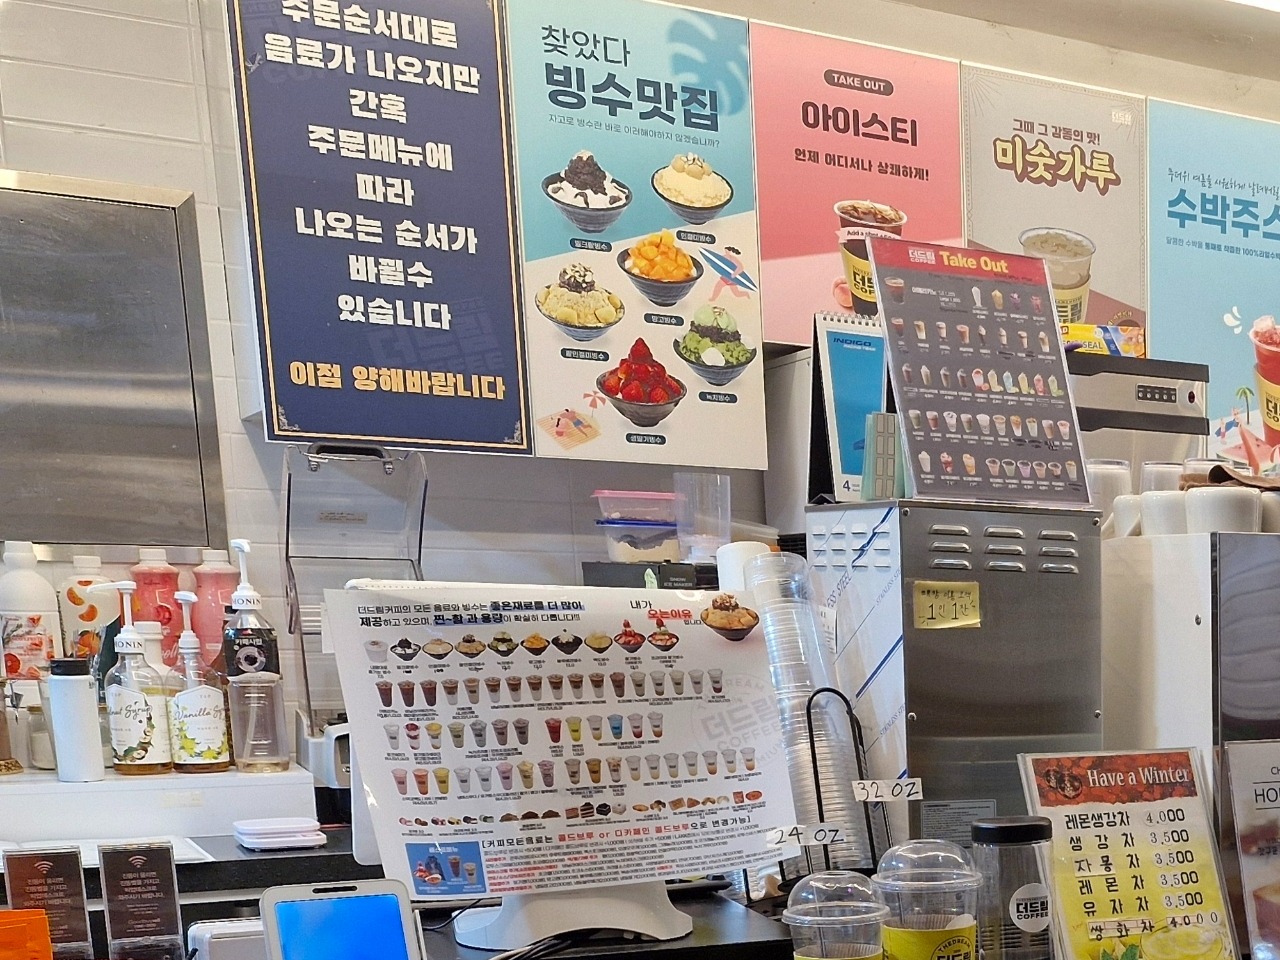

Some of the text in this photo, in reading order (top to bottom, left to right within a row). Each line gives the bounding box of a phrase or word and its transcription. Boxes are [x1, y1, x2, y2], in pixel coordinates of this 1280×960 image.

[282, 0, 458, 49] 주문순서대로
[542, 25, 630, 67] 찾았다
[265, 33, 480, 94] 음료가 나오지만
[832, 73, 886, 92] TAKE OUT
[349, 89, 406, 123] 간혹
[545, 63, 719, 132] 빙수맛집
[549, 114, 720, 148] 자고로 빙수란 바로 이러해야하지 않겠습니까?
[802, 101, 918, 147] 아이스티
[1012, 119, 1100, 145] 그때 그 감동의 맛!
[308, 125, 453, 171] 주문메뉴에
[795, 148, 929, 181] 언제 어디서나 상쾌하게!
[994, 135, 1121, 195] 미숫가루
[356, 173, 414, 206] 따라
[295, 208, 477, 253] 나오는 순서가
[1166, 237, 1183, 246] 달콤한
[1205, 242, 1222, 251] 통째로
[939, 251, 1008, 273] Take Out
[337, 295, 452, 330] 있습니다
[833, 338, 871, 346] INDIGO
[290, 362, 505, 399] 이점 양해바랍니다
[358, 605, 411, 614] 더드림커피의
[414, 604, 432, 613] 모든
[434, 603, 459, 612] 음료와
[548, 602, 558, 610] 더
[561, 601, 582, 610] 많이
[630, 600, 652, 609] 내가
[648, 609, 692, 619] 오는이유
[360, 617, 432, 627] 제공하고 있으며,
[174, 707, 211, 720] Vanilla
[857, 782, 919, 798] 32 OZ
[1087, 767, 1190, 787] Have a Winter
[558, 831, 594, 842] 콜드브루
[615, 827, 650, 838] 디카페인
[656, 822, 708, 834] 콜드브루으로
[1064, 811, 1130, 830] 레몬생강차
[775, 826, 844, 843] 24 OZ
